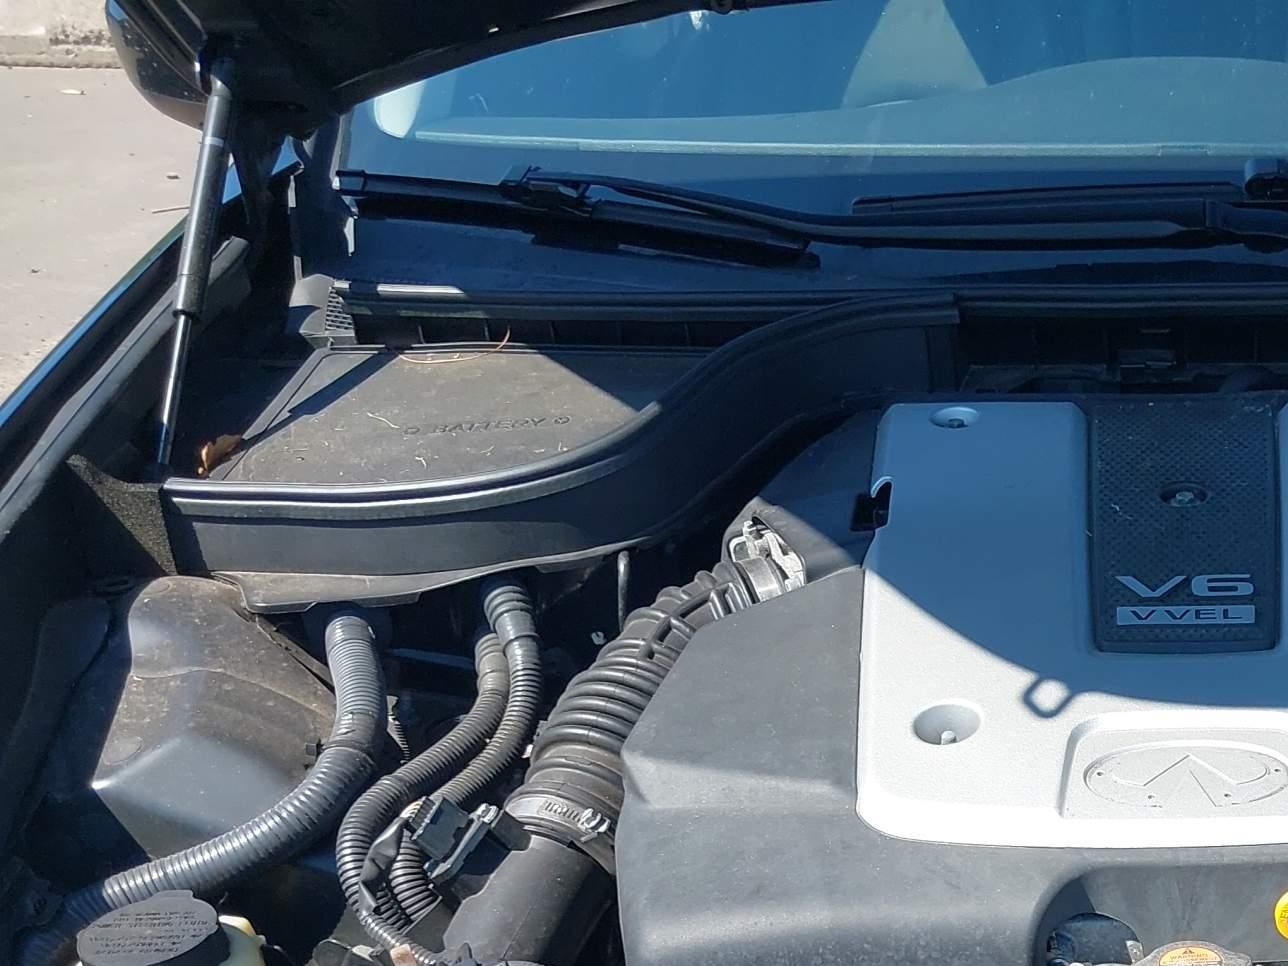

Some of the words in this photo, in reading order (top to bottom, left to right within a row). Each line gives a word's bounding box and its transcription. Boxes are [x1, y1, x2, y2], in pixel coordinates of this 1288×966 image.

[432, 416, 547, 434] BATTERY
[1114, 574, 1255, 598] V6
[1130, 608, 1243, 621] VVEL
